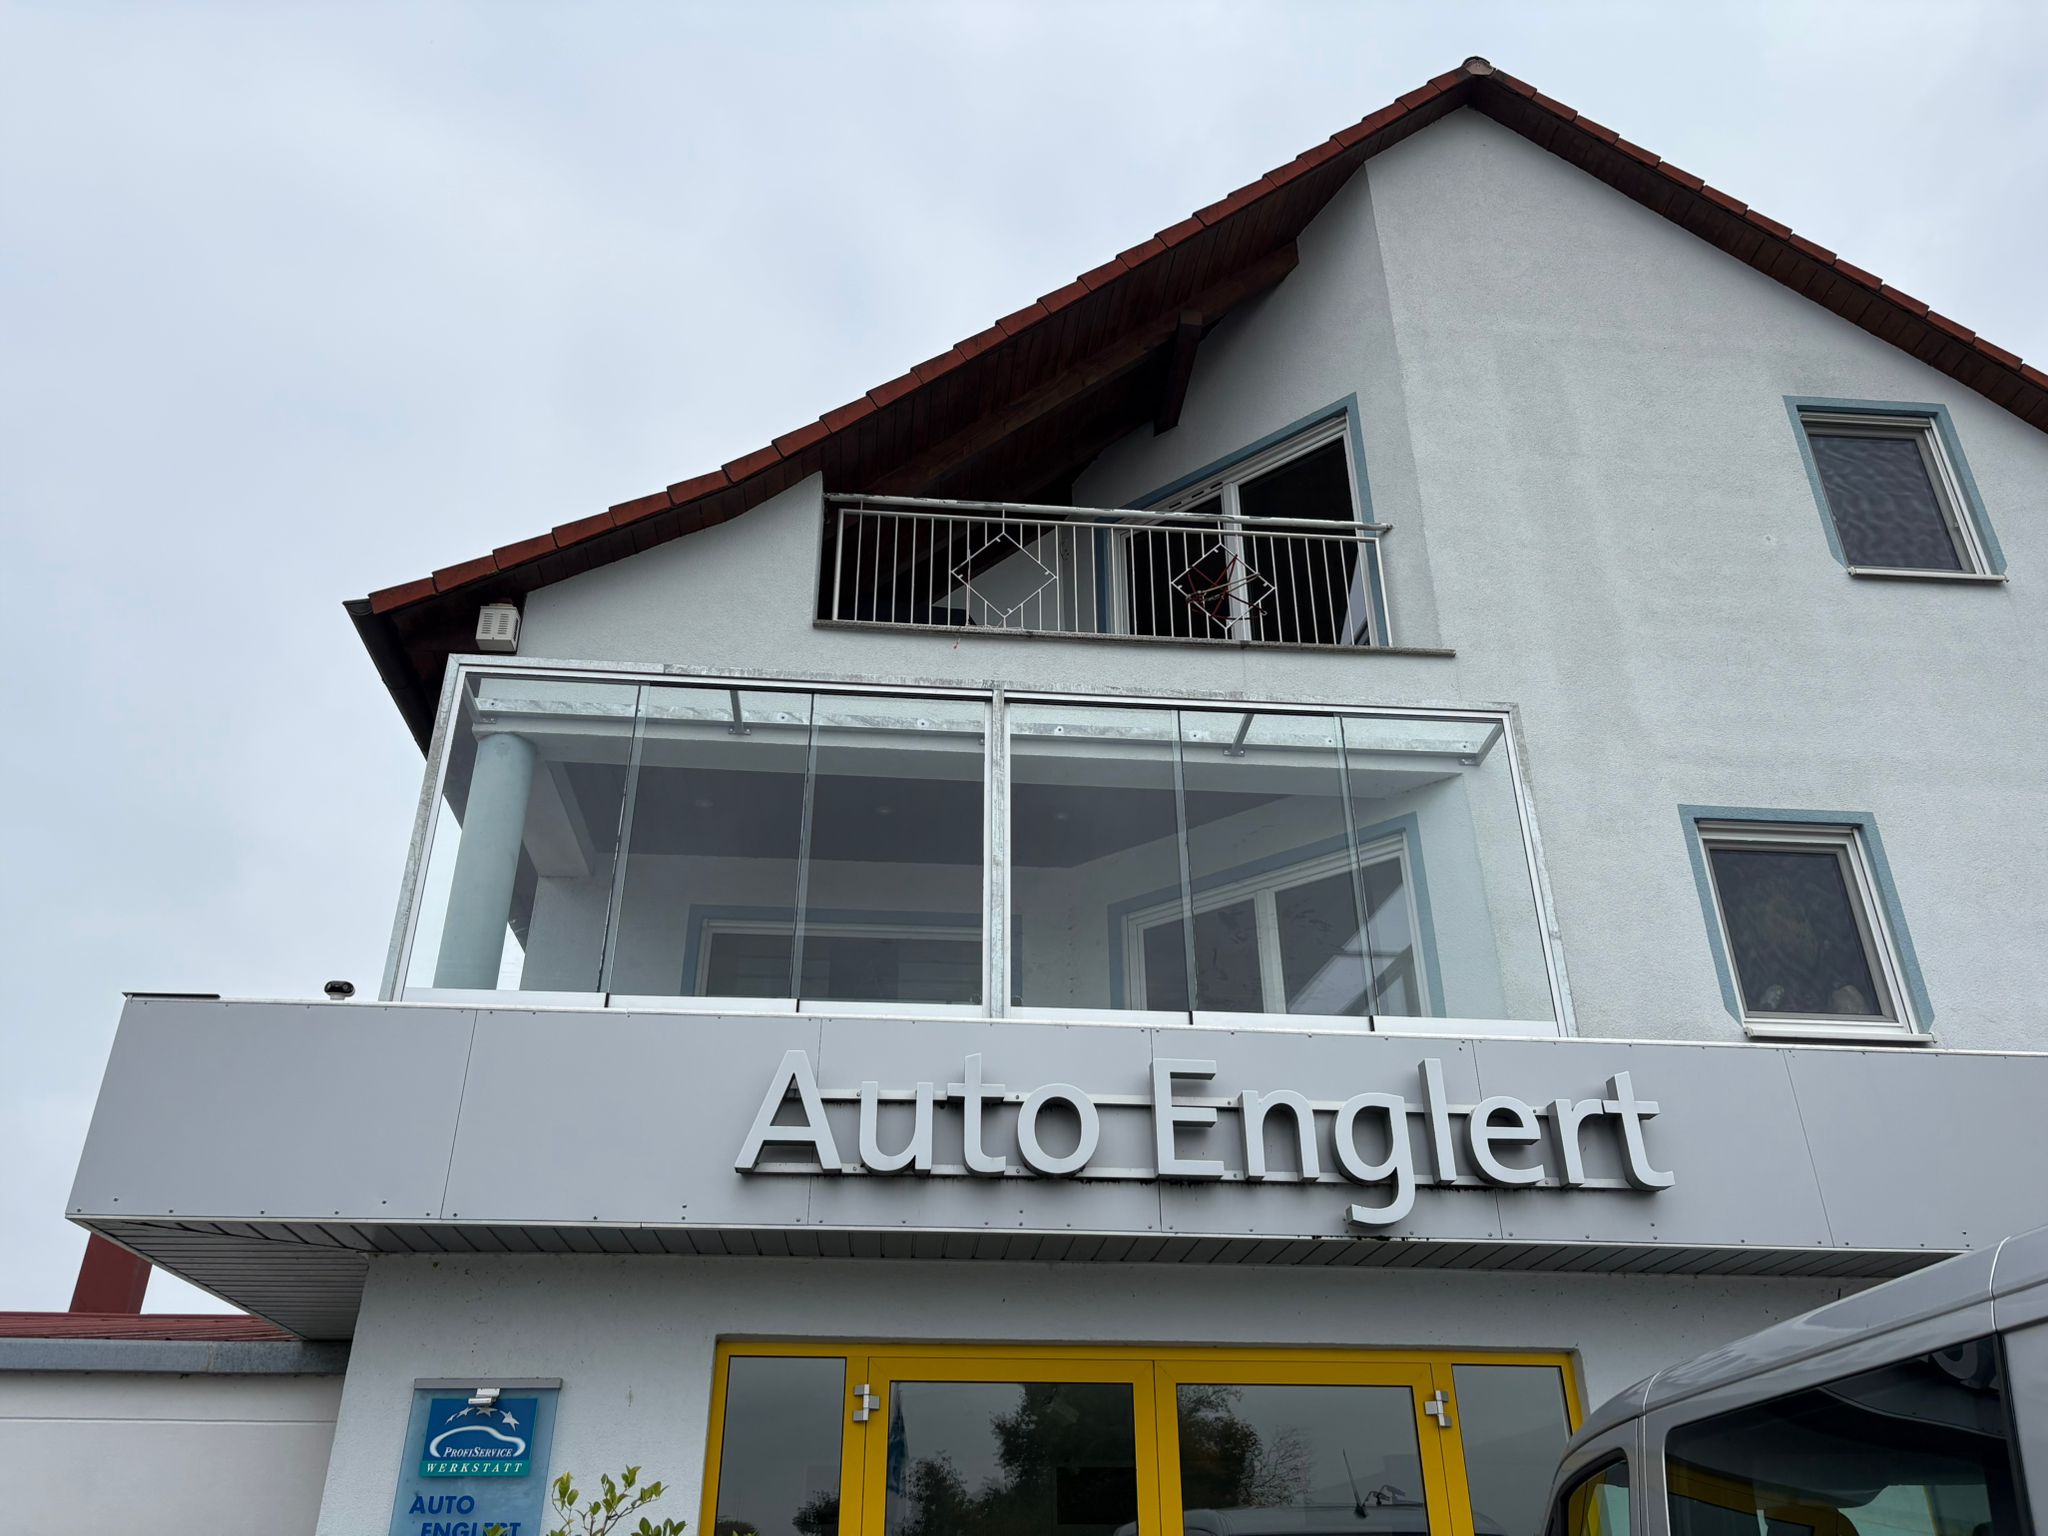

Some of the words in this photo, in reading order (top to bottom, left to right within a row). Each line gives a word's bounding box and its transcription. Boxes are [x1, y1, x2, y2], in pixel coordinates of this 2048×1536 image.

[734, 1050, 1100, 1177] Auto
[1149, 1057, 1676, 1227] Englert
[426, 1462, 523, 1473] WERKSTATT
[408, 1495, 475, 1515] AUTO
